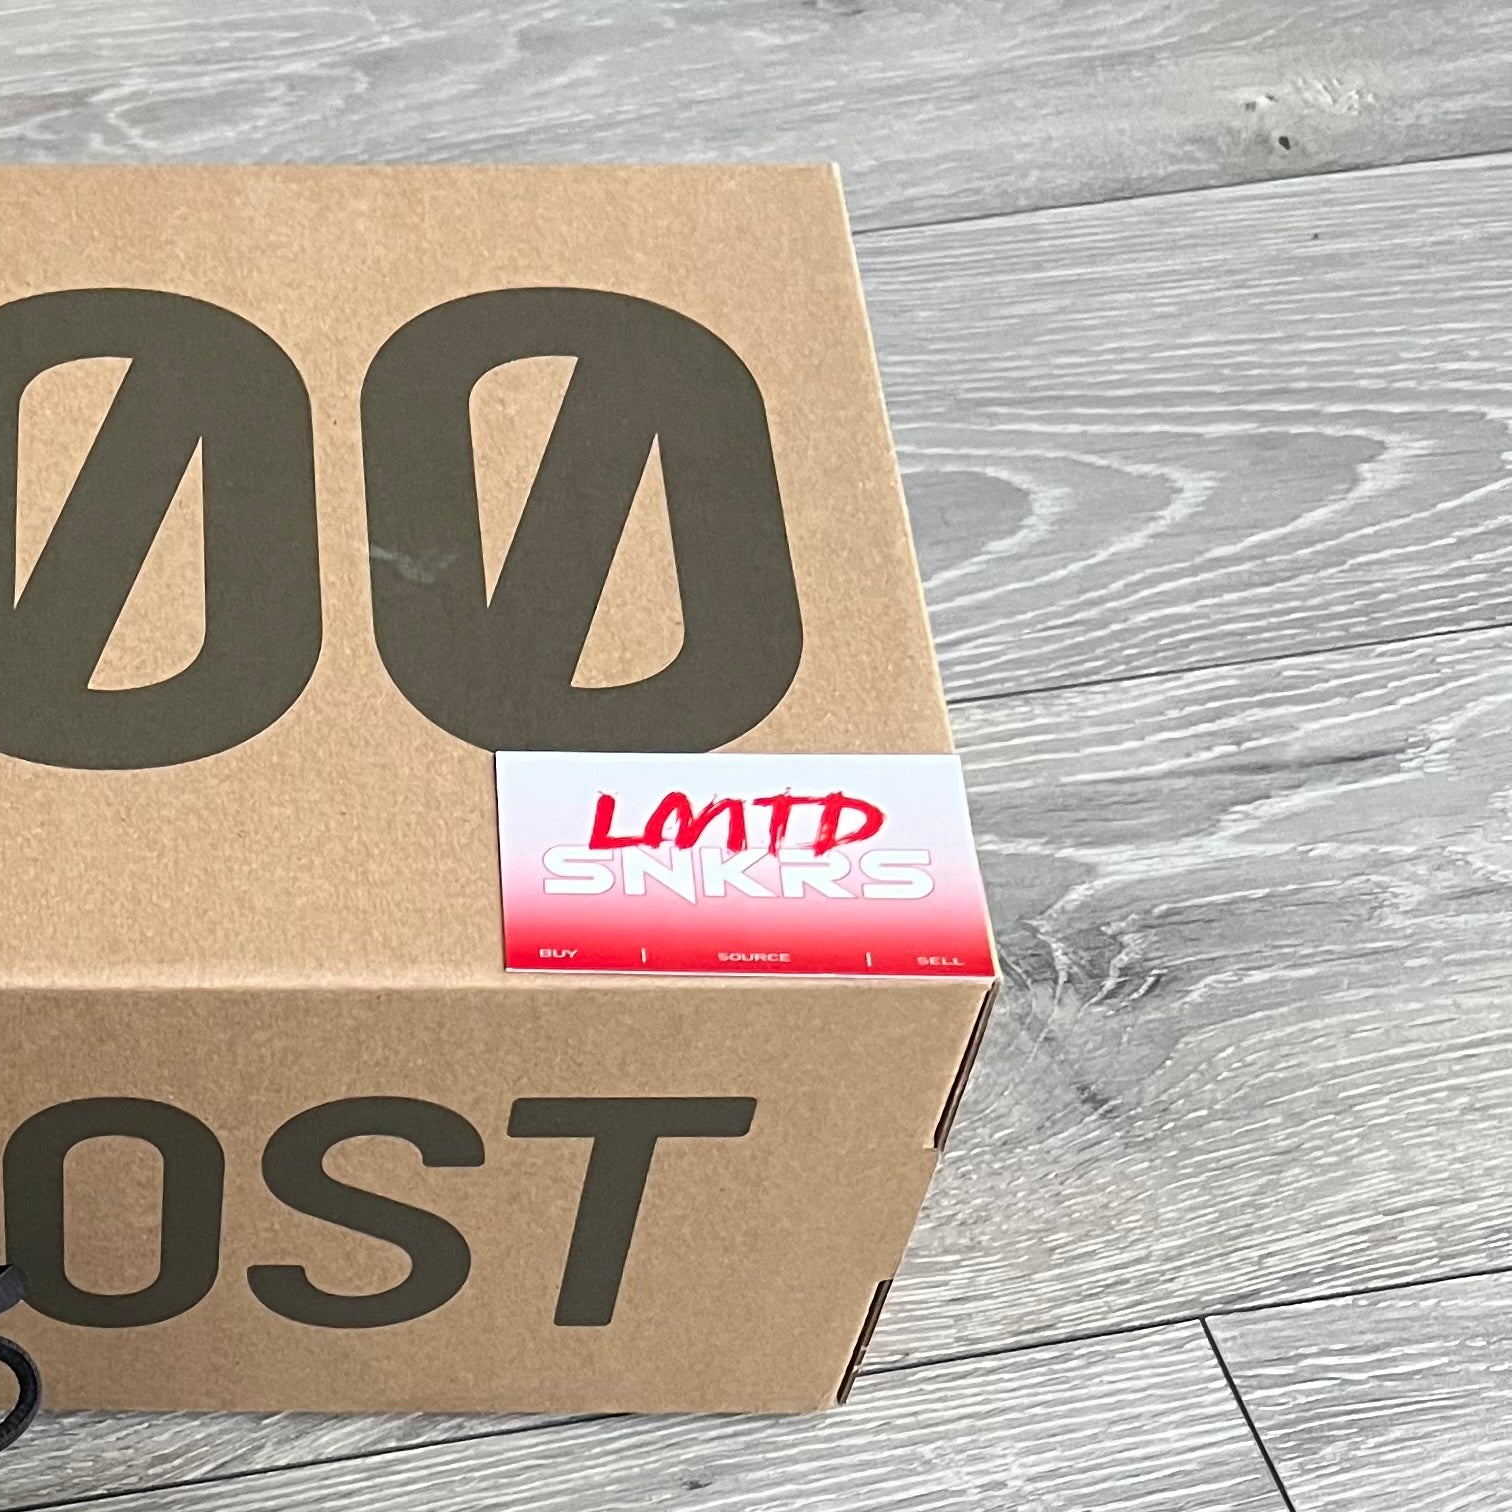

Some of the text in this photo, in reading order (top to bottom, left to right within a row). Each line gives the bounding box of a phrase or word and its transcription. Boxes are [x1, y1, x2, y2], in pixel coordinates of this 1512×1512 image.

[589, 788, 887, 857] LMTD
[542, 844, 935, 904] SNKRS
[539, 948, 965, 966] BUY SOURCE SELL
